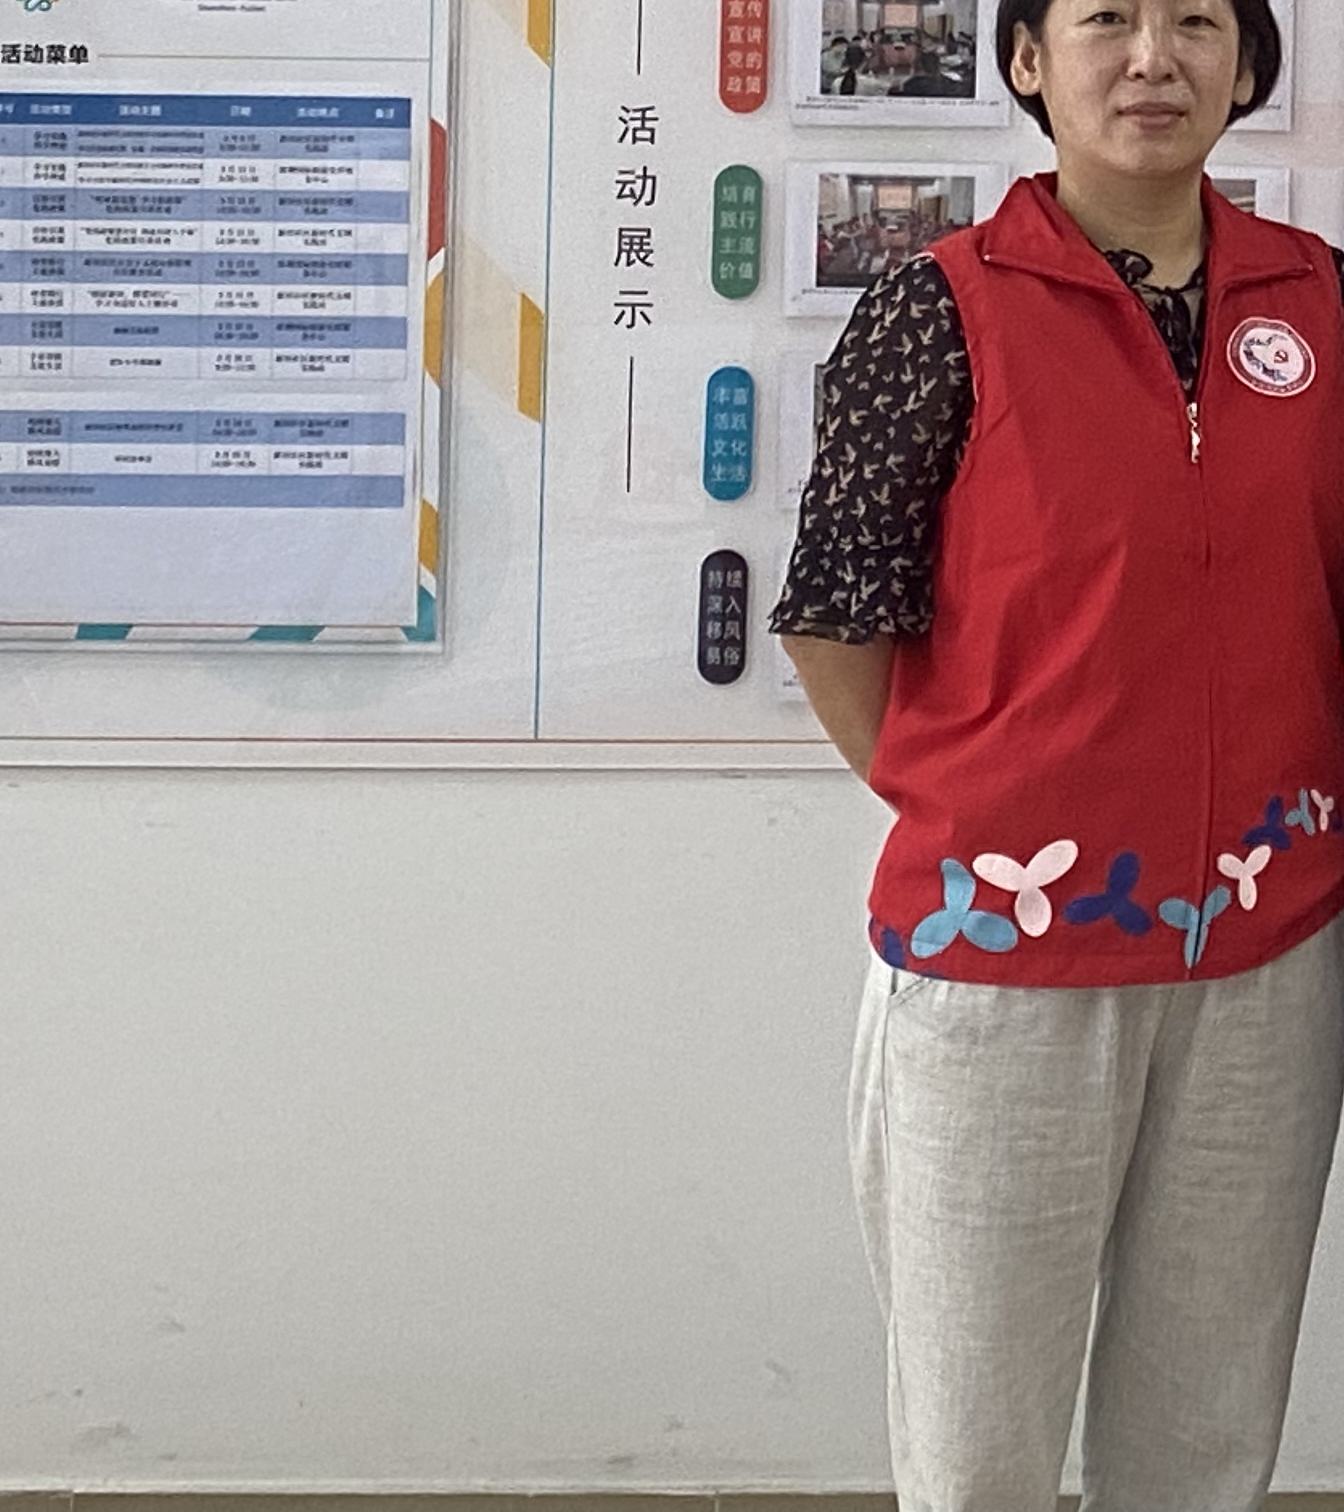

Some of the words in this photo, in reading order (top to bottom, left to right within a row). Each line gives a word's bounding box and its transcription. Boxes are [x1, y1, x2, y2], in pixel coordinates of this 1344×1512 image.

[0, 43, 90, 65] 活动菜单
[614, 104, 660, 330] 活动展示
